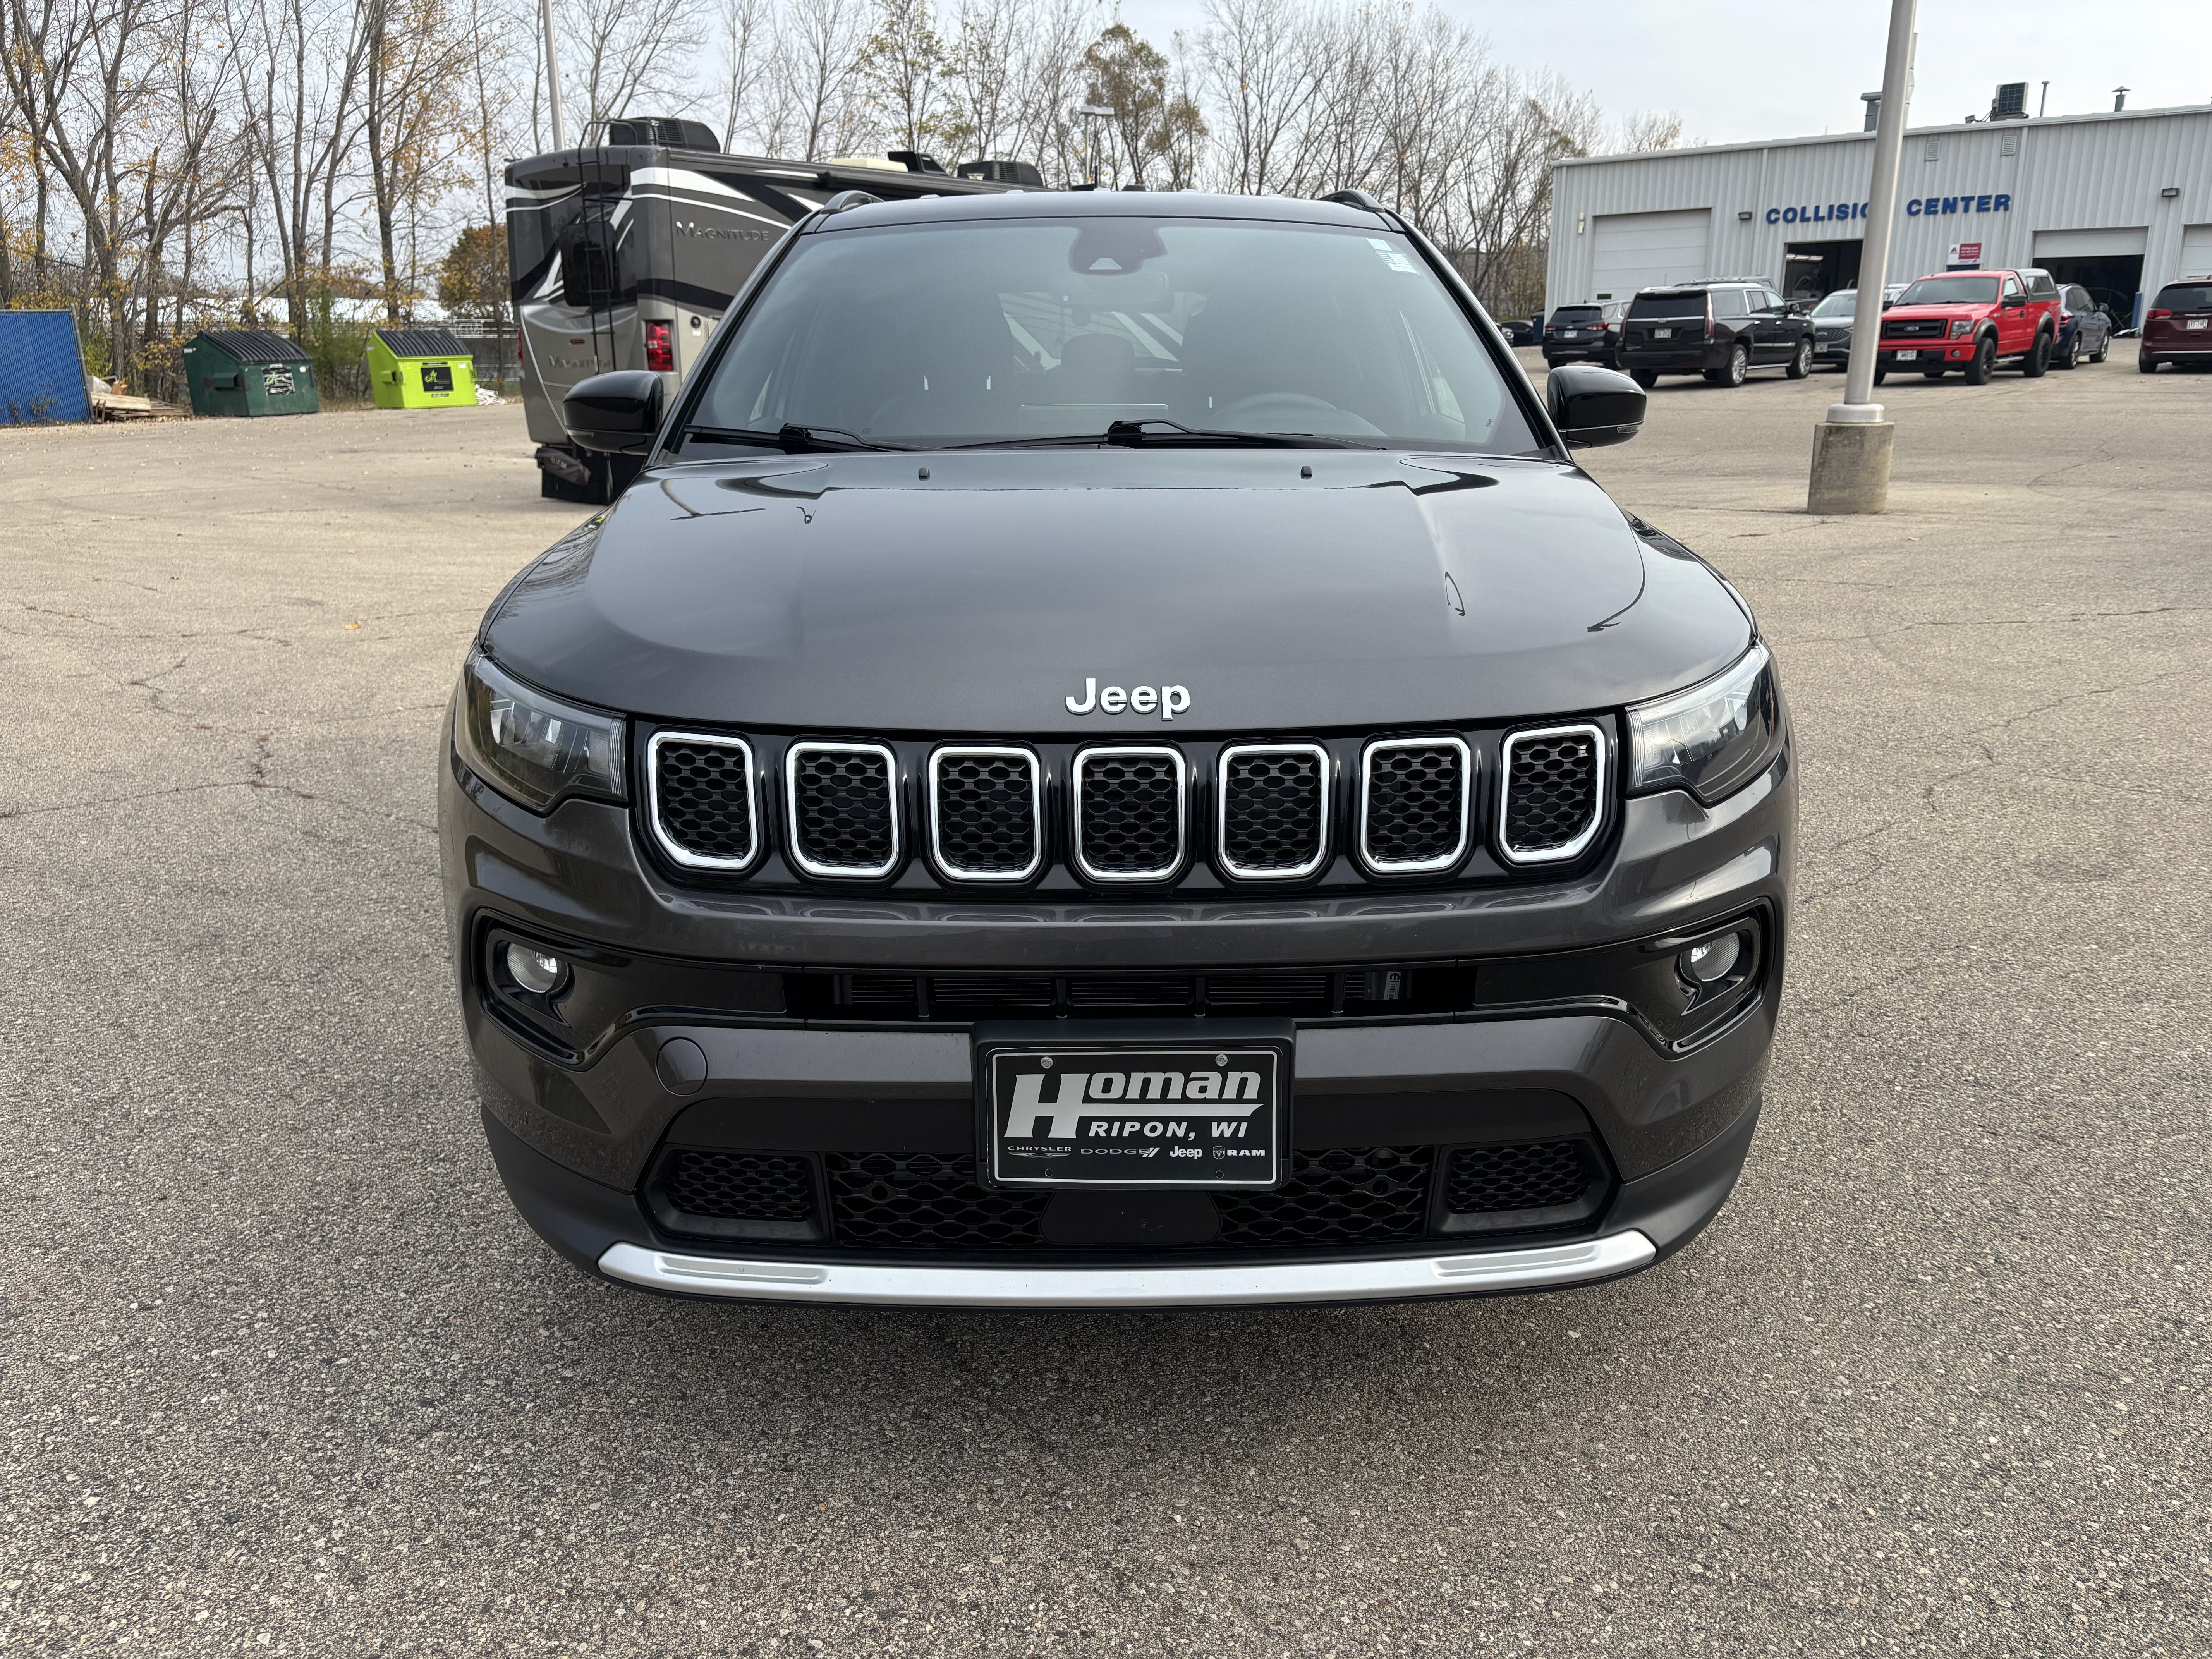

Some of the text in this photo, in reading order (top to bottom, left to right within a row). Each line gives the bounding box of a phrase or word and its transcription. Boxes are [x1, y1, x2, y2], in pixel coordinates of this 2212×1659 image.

[1906, 194, 2011, 216] CENTER
[676, 221, 770, 241] MAGNITUDE
[1065, 678, 1191, 721] Jeep
[1004, 1071, 1263, 1139] Homan
[1088, 1121, 1249, 1141] RIPON, WI
[1169, 1145, 1203, 1160] Jeep
